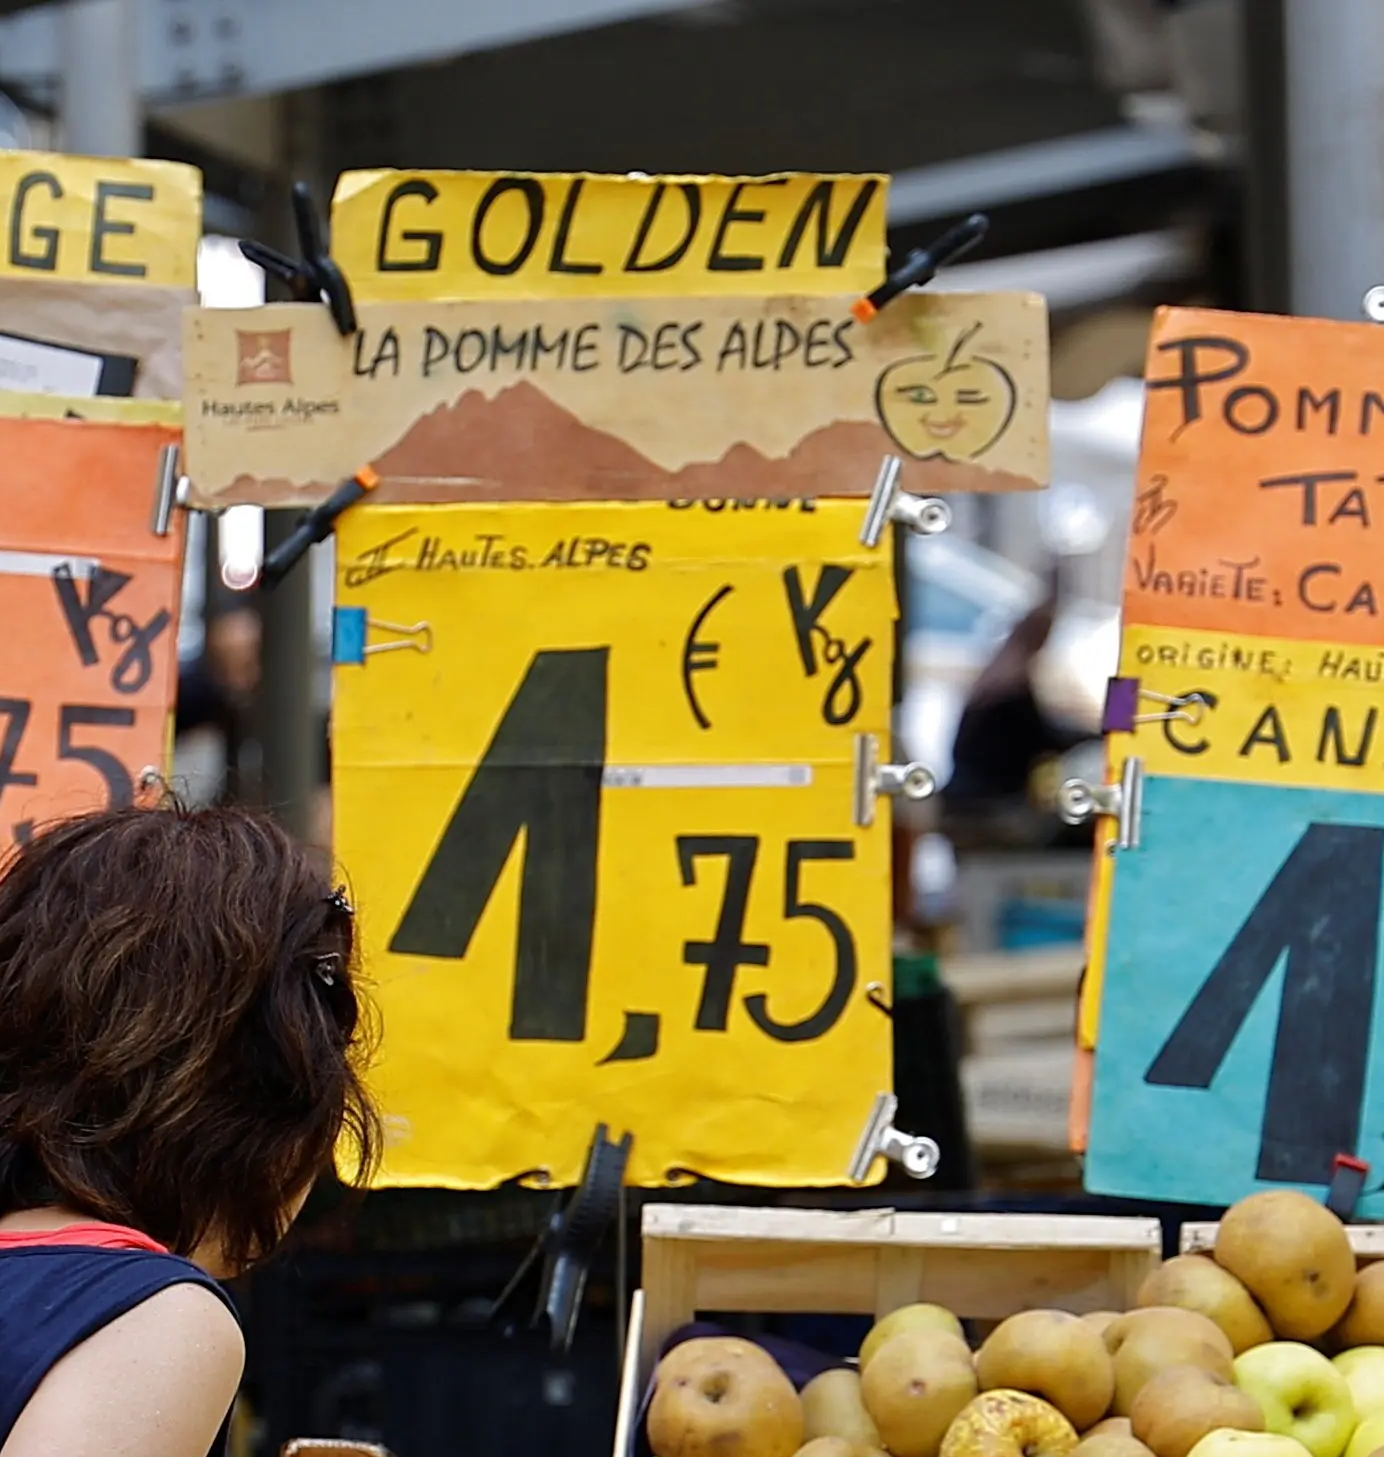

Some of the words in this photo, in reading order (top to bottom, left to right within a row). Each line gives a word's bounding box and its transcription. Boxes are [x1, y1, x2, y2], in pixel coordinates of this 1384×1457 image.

[376, 177, 880, 276] GOLDEN
[353, 327, 402, 380] LA
[422, 322, 600, 375] POMME
[618, 320, 706, 372] DES
[716, 317, 855, 373] ALPES
[201, 400, 275, 417] Hautes
[281, 397, 340, 423] Alpes
[51, 560, 172, 695] Kg
[782, 564, 874, 725] Kg
